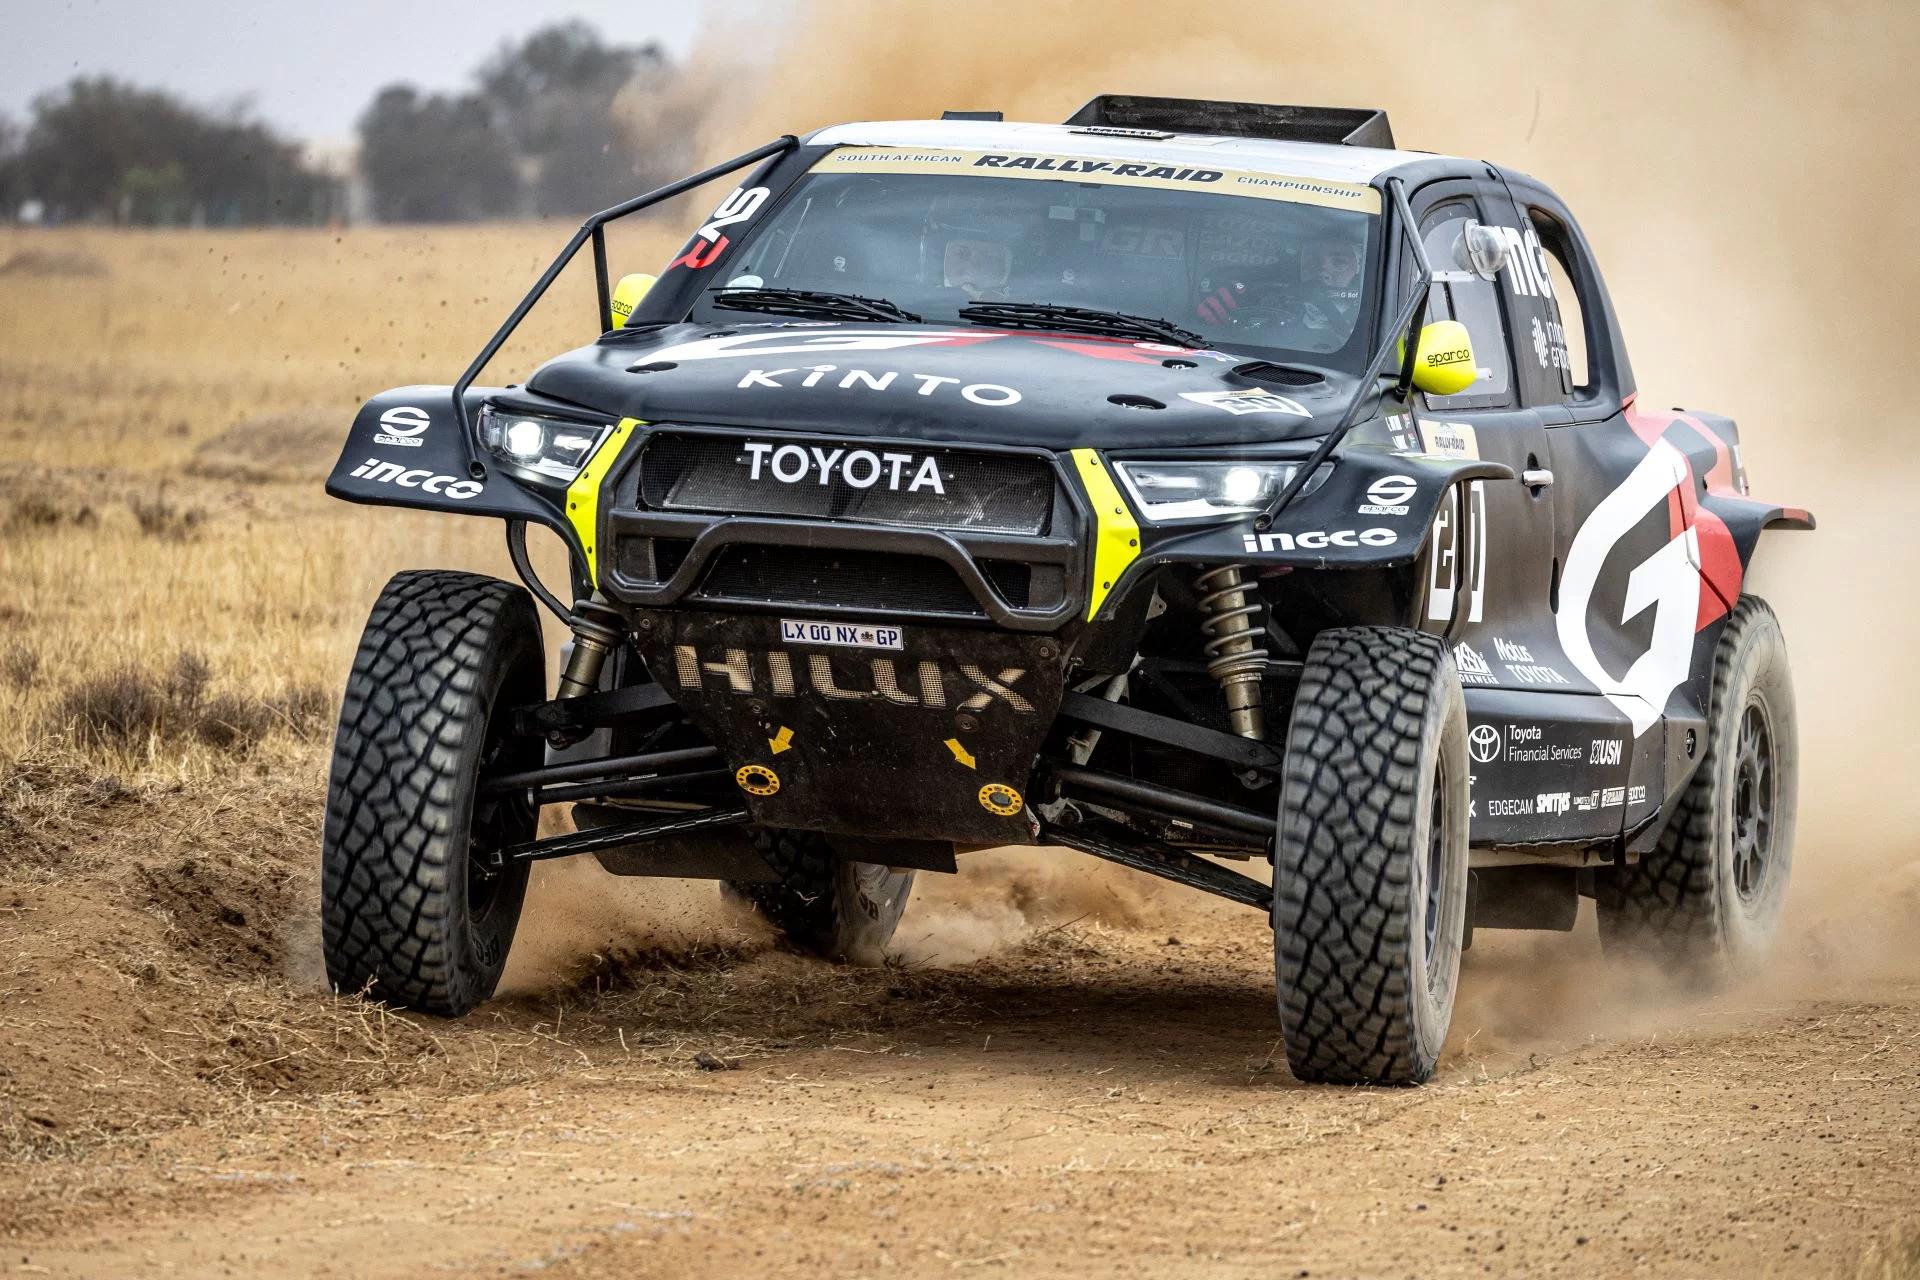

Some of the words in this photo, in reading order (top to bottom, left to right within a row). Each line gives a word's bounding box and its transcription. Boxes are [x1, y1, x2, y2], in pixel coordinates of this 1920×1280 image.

[837, 154, 890, 163] SOUTH
[893, 154, 963, 163] AFRICAN
[972, 154, 1224, 184] RALLY-RAID
[1237, 175, 1363, 198] CHAMPIONSHIP
[1427, 349, 1470, 368] sparco
[743, 442, 945, 495] TOYOTA
[784, 622, 806, 640] LX
[836, 626, 858, 643] NX
[876, 629, 897, 646] GP
[675, 645, 1034, 714] HILUX
[1459, 674, 1500, 685] ORKWEAR
[1505, 664, 1571, 684] TOYOTA
[1509, 725, 1541, 744] Toyota
[1509, 745, 1549, 762] Financial
[1550, 745, 1582, 761] Services
[1600, 739, 1623, 765] USN
[1488, 799, 1533, 816] EDGECAM
